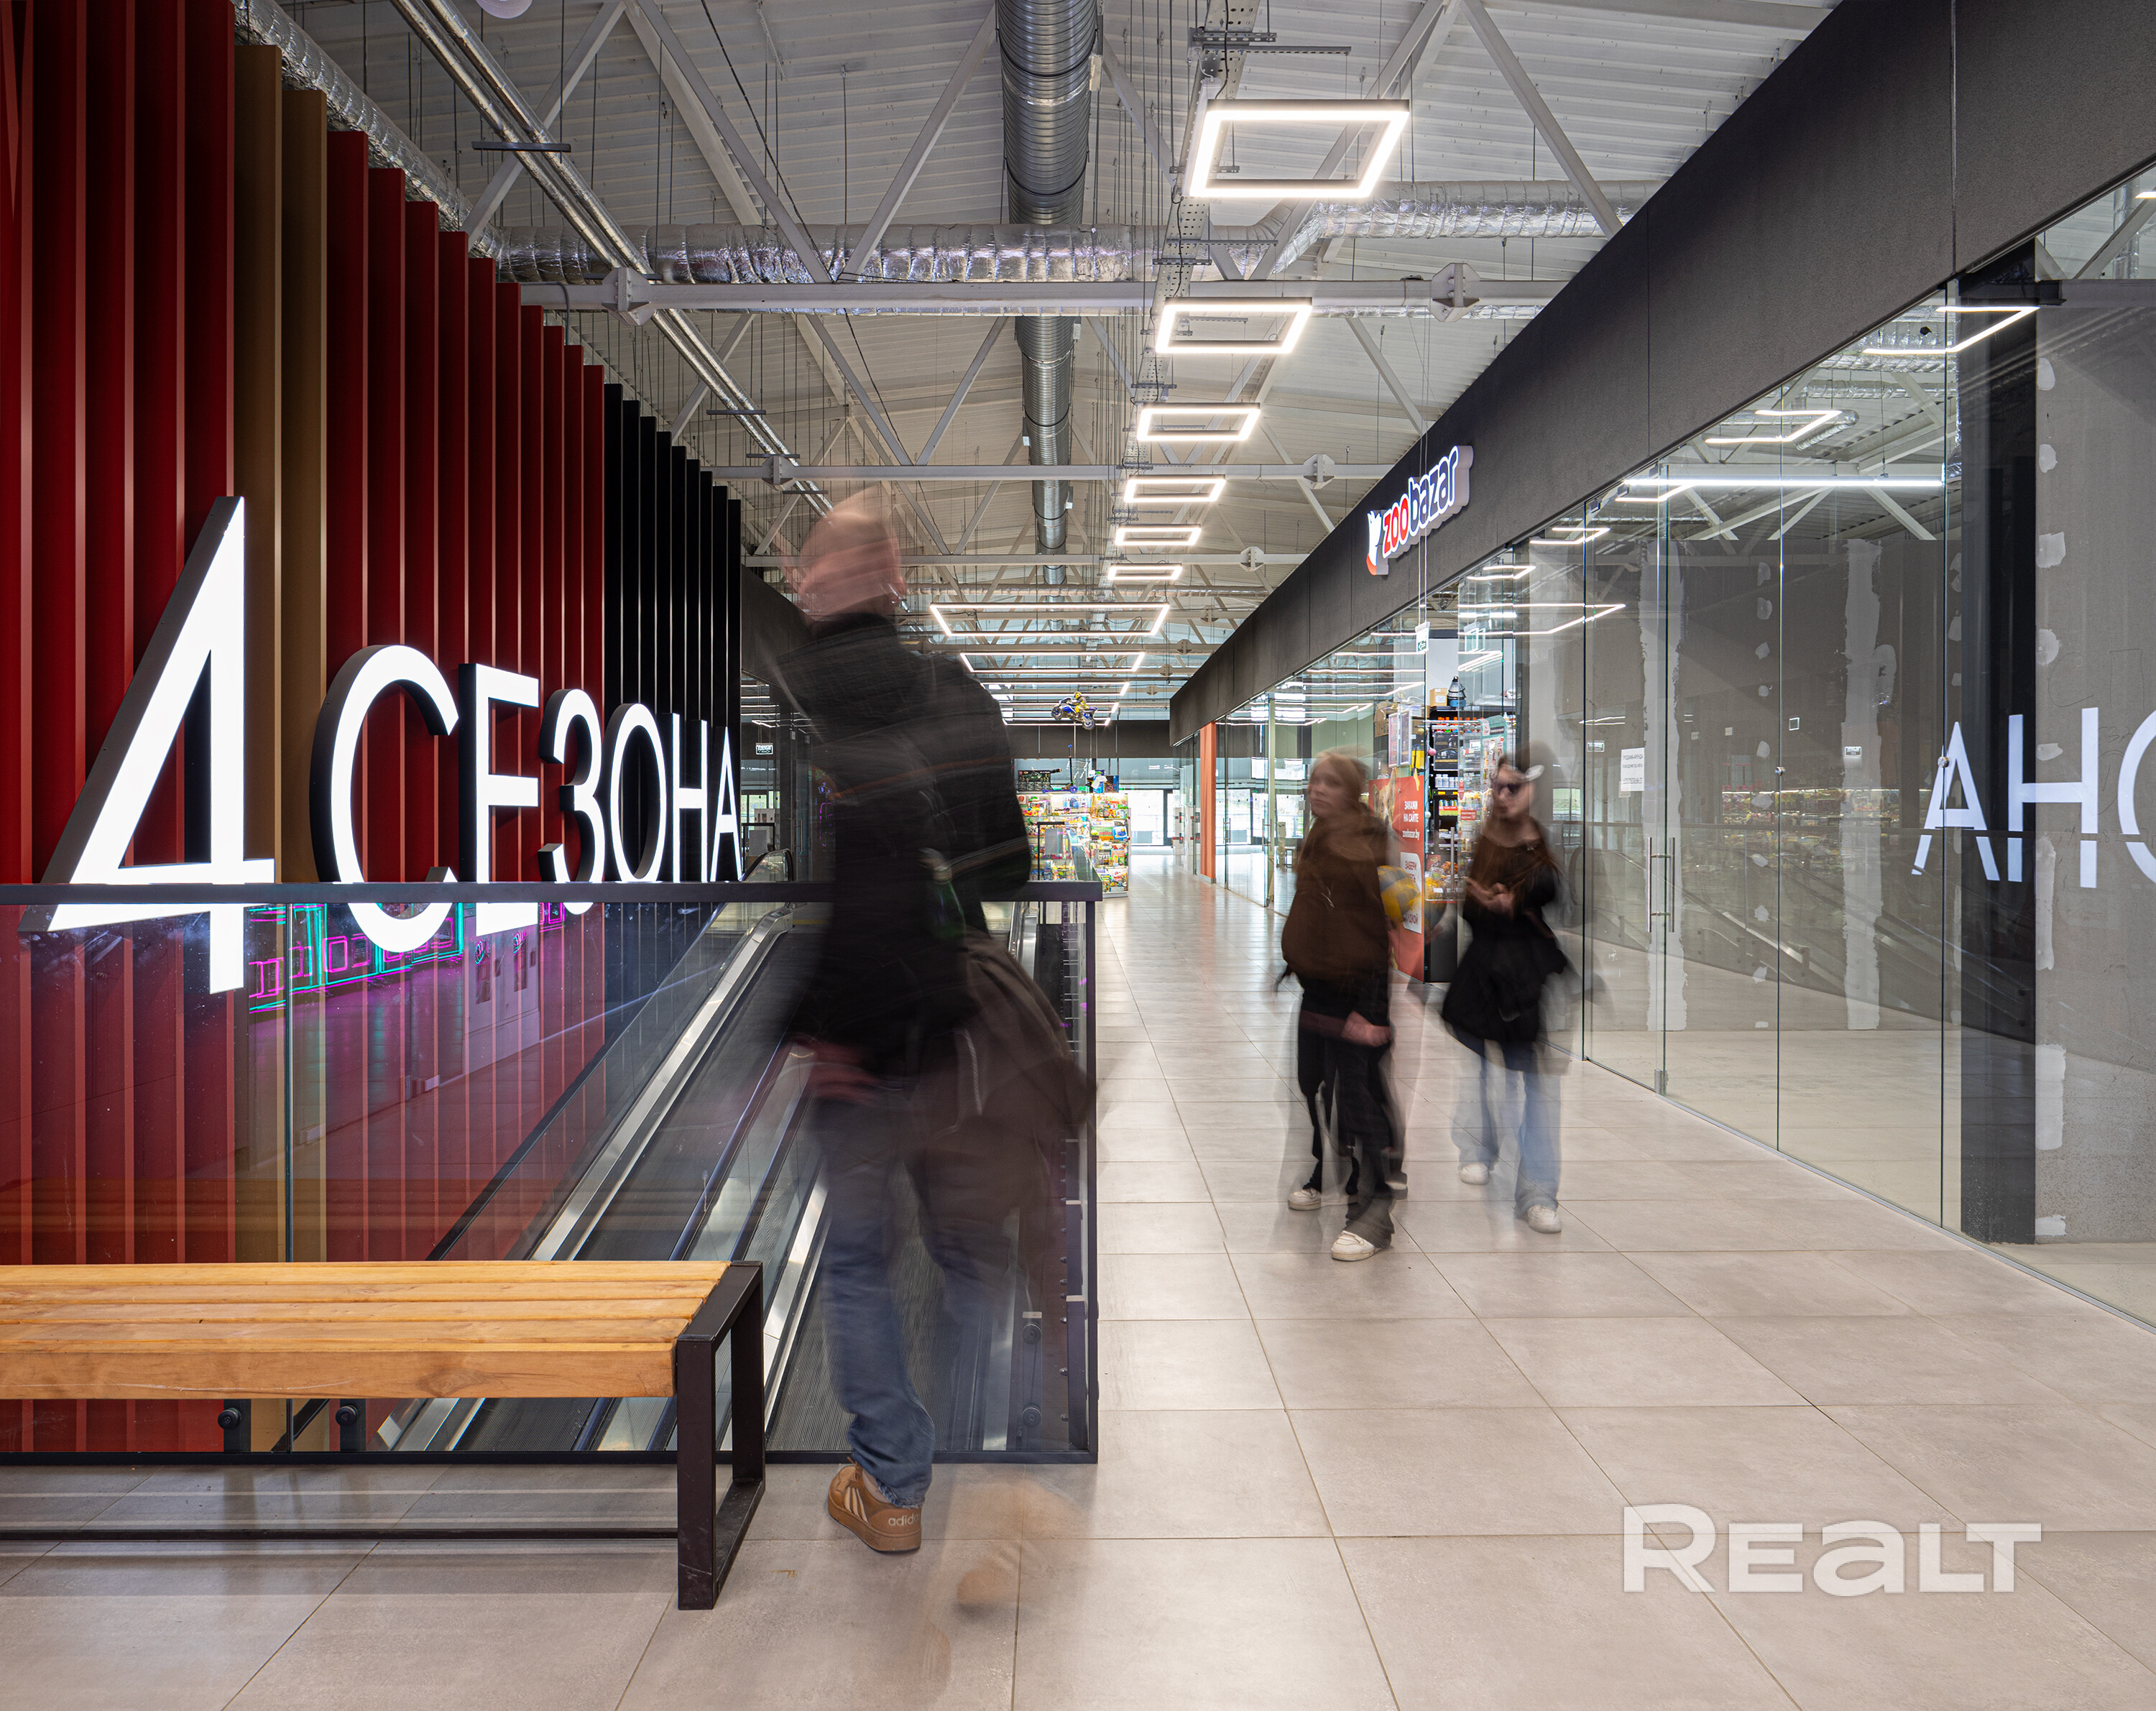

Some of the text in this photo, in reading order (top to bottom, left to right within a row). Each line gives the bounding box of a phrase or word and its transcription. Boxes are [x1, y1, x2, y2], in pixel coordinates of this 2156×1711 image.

[1383, 447, 1458, 557] zoobazar
[22, 496, 742, 995] 4 СЕЗОНА
[1403, 811, 1419, 823] НА САЙТЕ
[1404, 801, 1418, 810] ЗАКАЖИ
